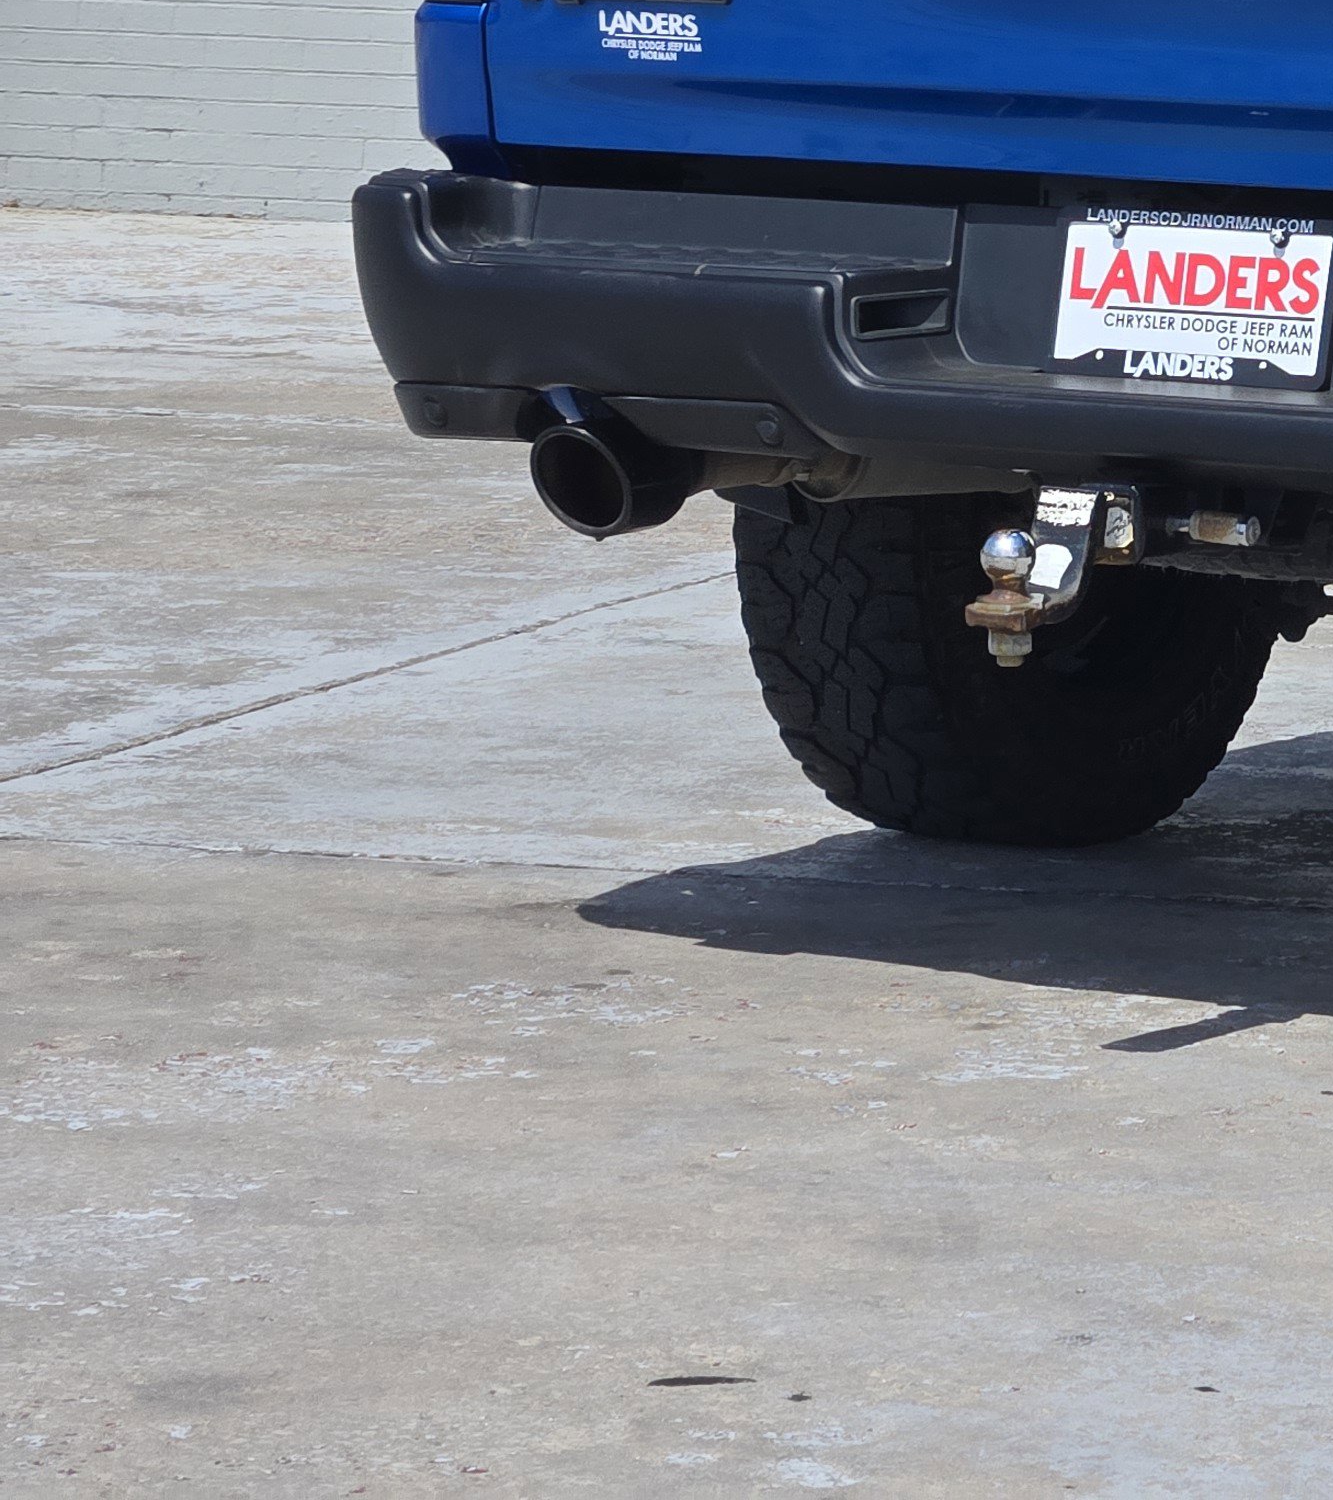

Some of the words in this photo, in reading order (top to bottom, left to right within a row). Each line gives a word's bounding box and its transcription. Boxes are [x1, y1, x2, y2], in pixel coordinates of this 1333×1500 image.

[599, 10, 698, 37] LANDERS
[628, 49, 640, 60] OF
[638, 40, 666, 51] DODGE
[1069, 246, 1320, 315] LANDERS
[1104, 312, 1175, 331] CHRYSLER
[1181, 317, 1237, 335] DODGE
[1241, 321, 1275, 337] JEEP
[1279, 324, 1313, 340] RAM
[1218, 336, 1238, 352] OF
[1243, 338, 1312, 357] NORMAN
[1123, 349, 1234, 382] LANDERS
